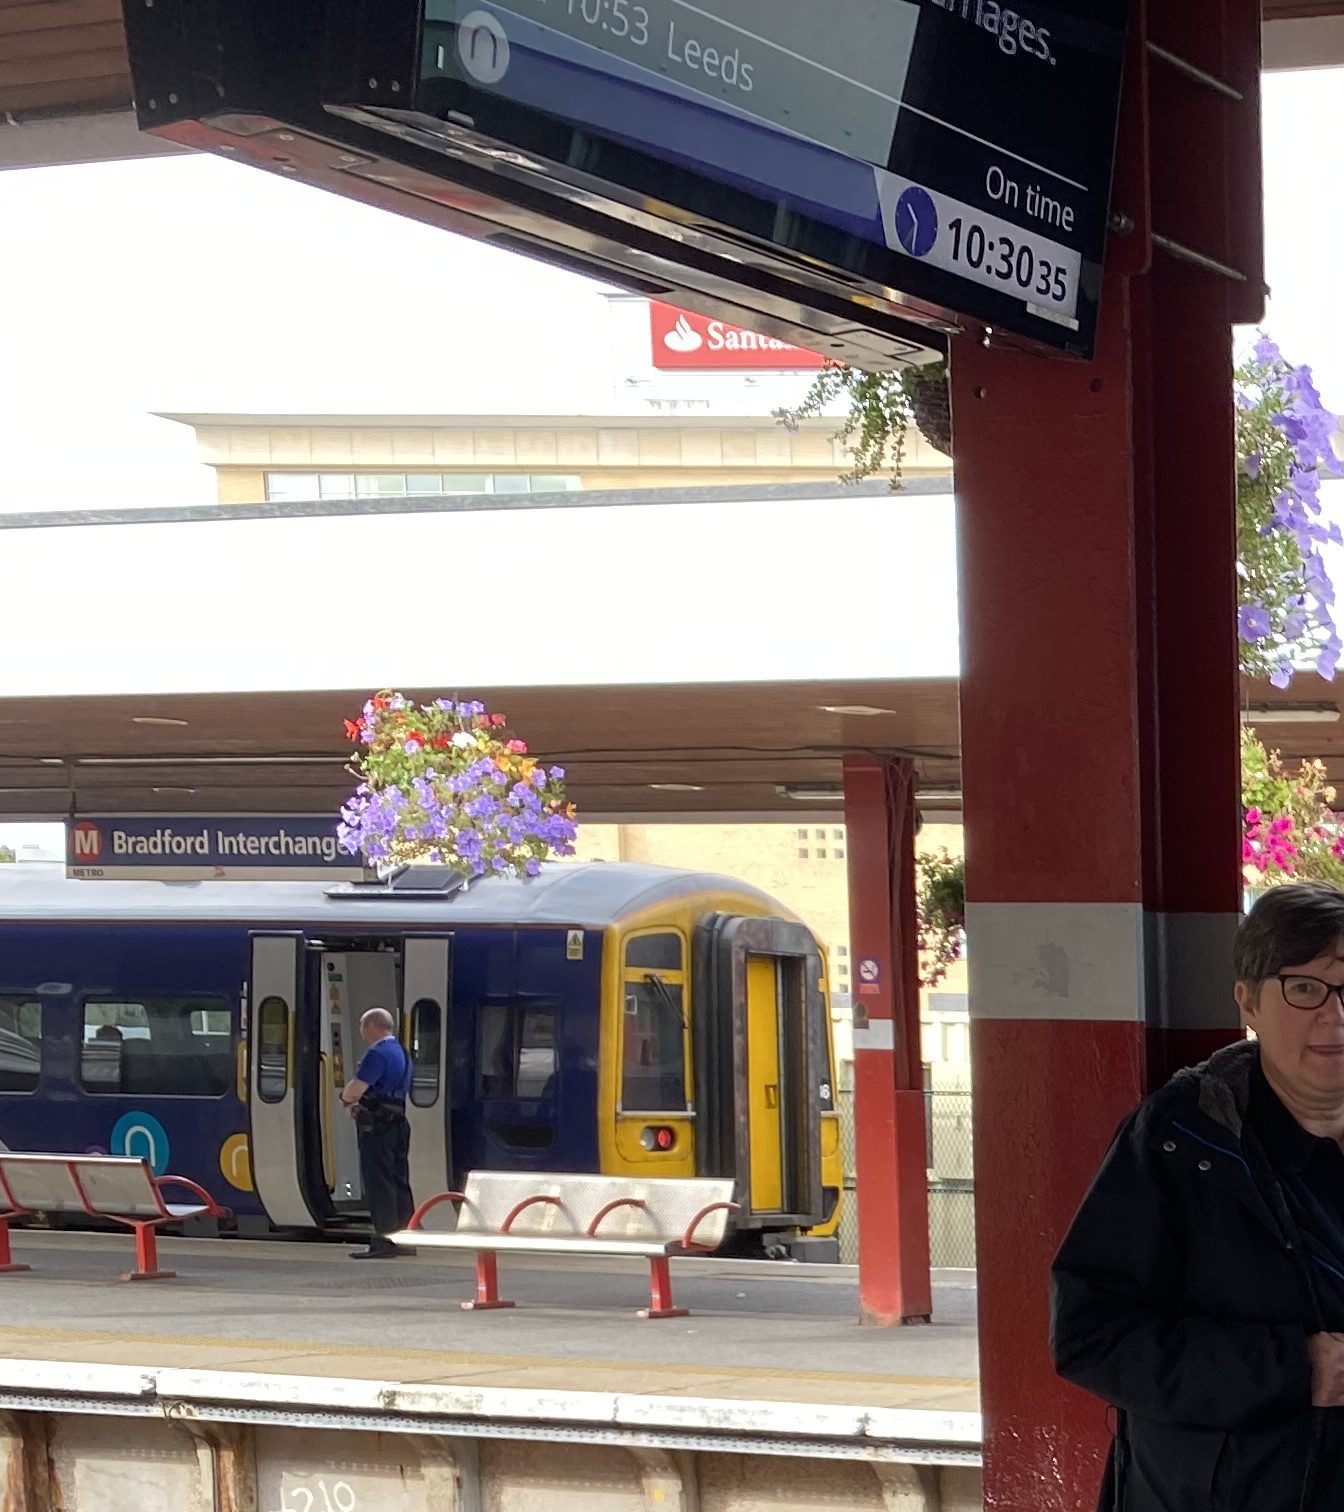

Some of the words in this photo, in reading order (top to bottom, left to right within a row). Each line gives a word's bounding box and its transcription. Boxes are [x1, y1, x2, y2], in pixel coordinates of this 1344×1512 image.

[667, 21, 754, 92] Leeds
[986, 165, 1018, 209] On
[1026, 183, 1075, 233] time
[948, 217, 1034, 288] 10:30
[1036, 259, 1068, 302] 35
[73, 869, 104, 877] METRO
[113, 830, 209, 855] Bradford
